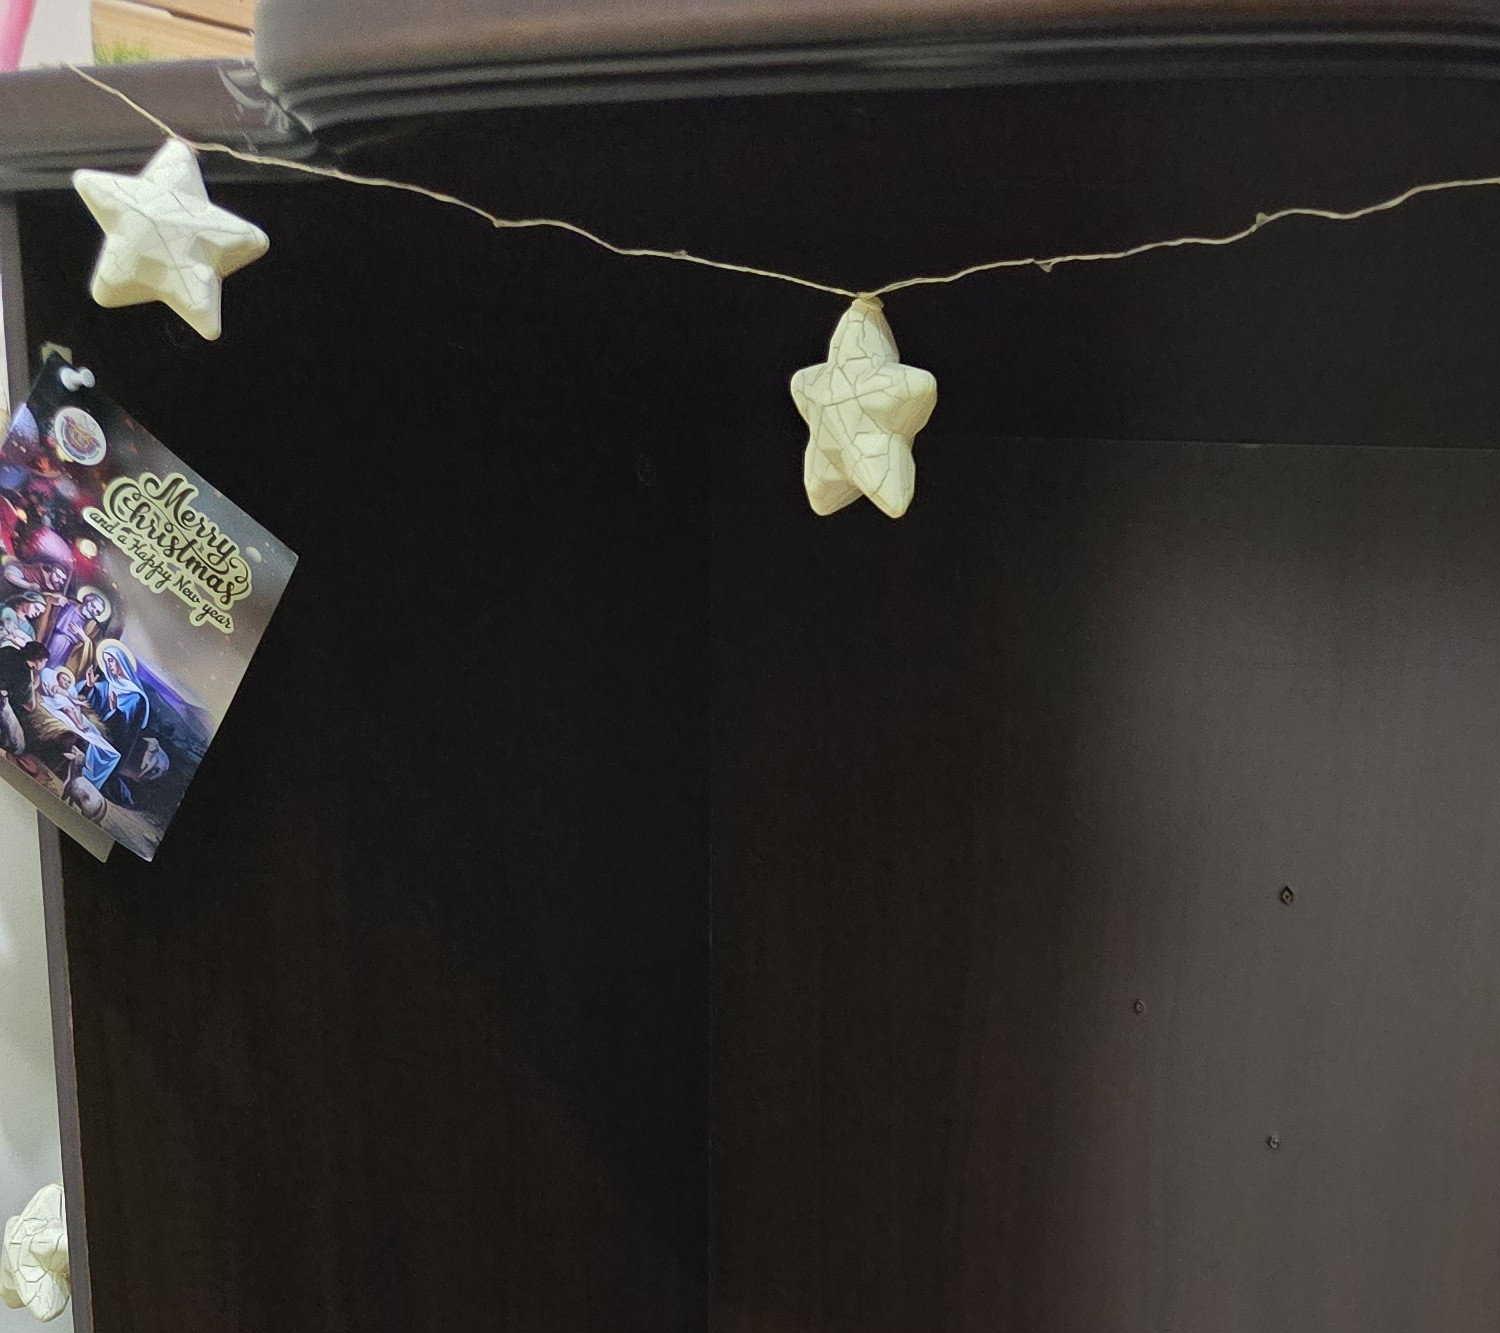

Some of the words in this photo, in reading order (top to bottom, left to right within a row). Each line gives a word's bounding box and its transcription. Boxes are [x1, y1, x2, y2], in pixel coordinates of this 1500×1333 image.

[89, 511, 120, 534] and
[117, 534, 128, 545] a
[128, 538, 172, 589] Happy
[172, 574, 201, 604] New
[195, 602, 232, 629] year
[109, 482, 249, 605] Christmas
[144, 477, 237, 566] Merry
